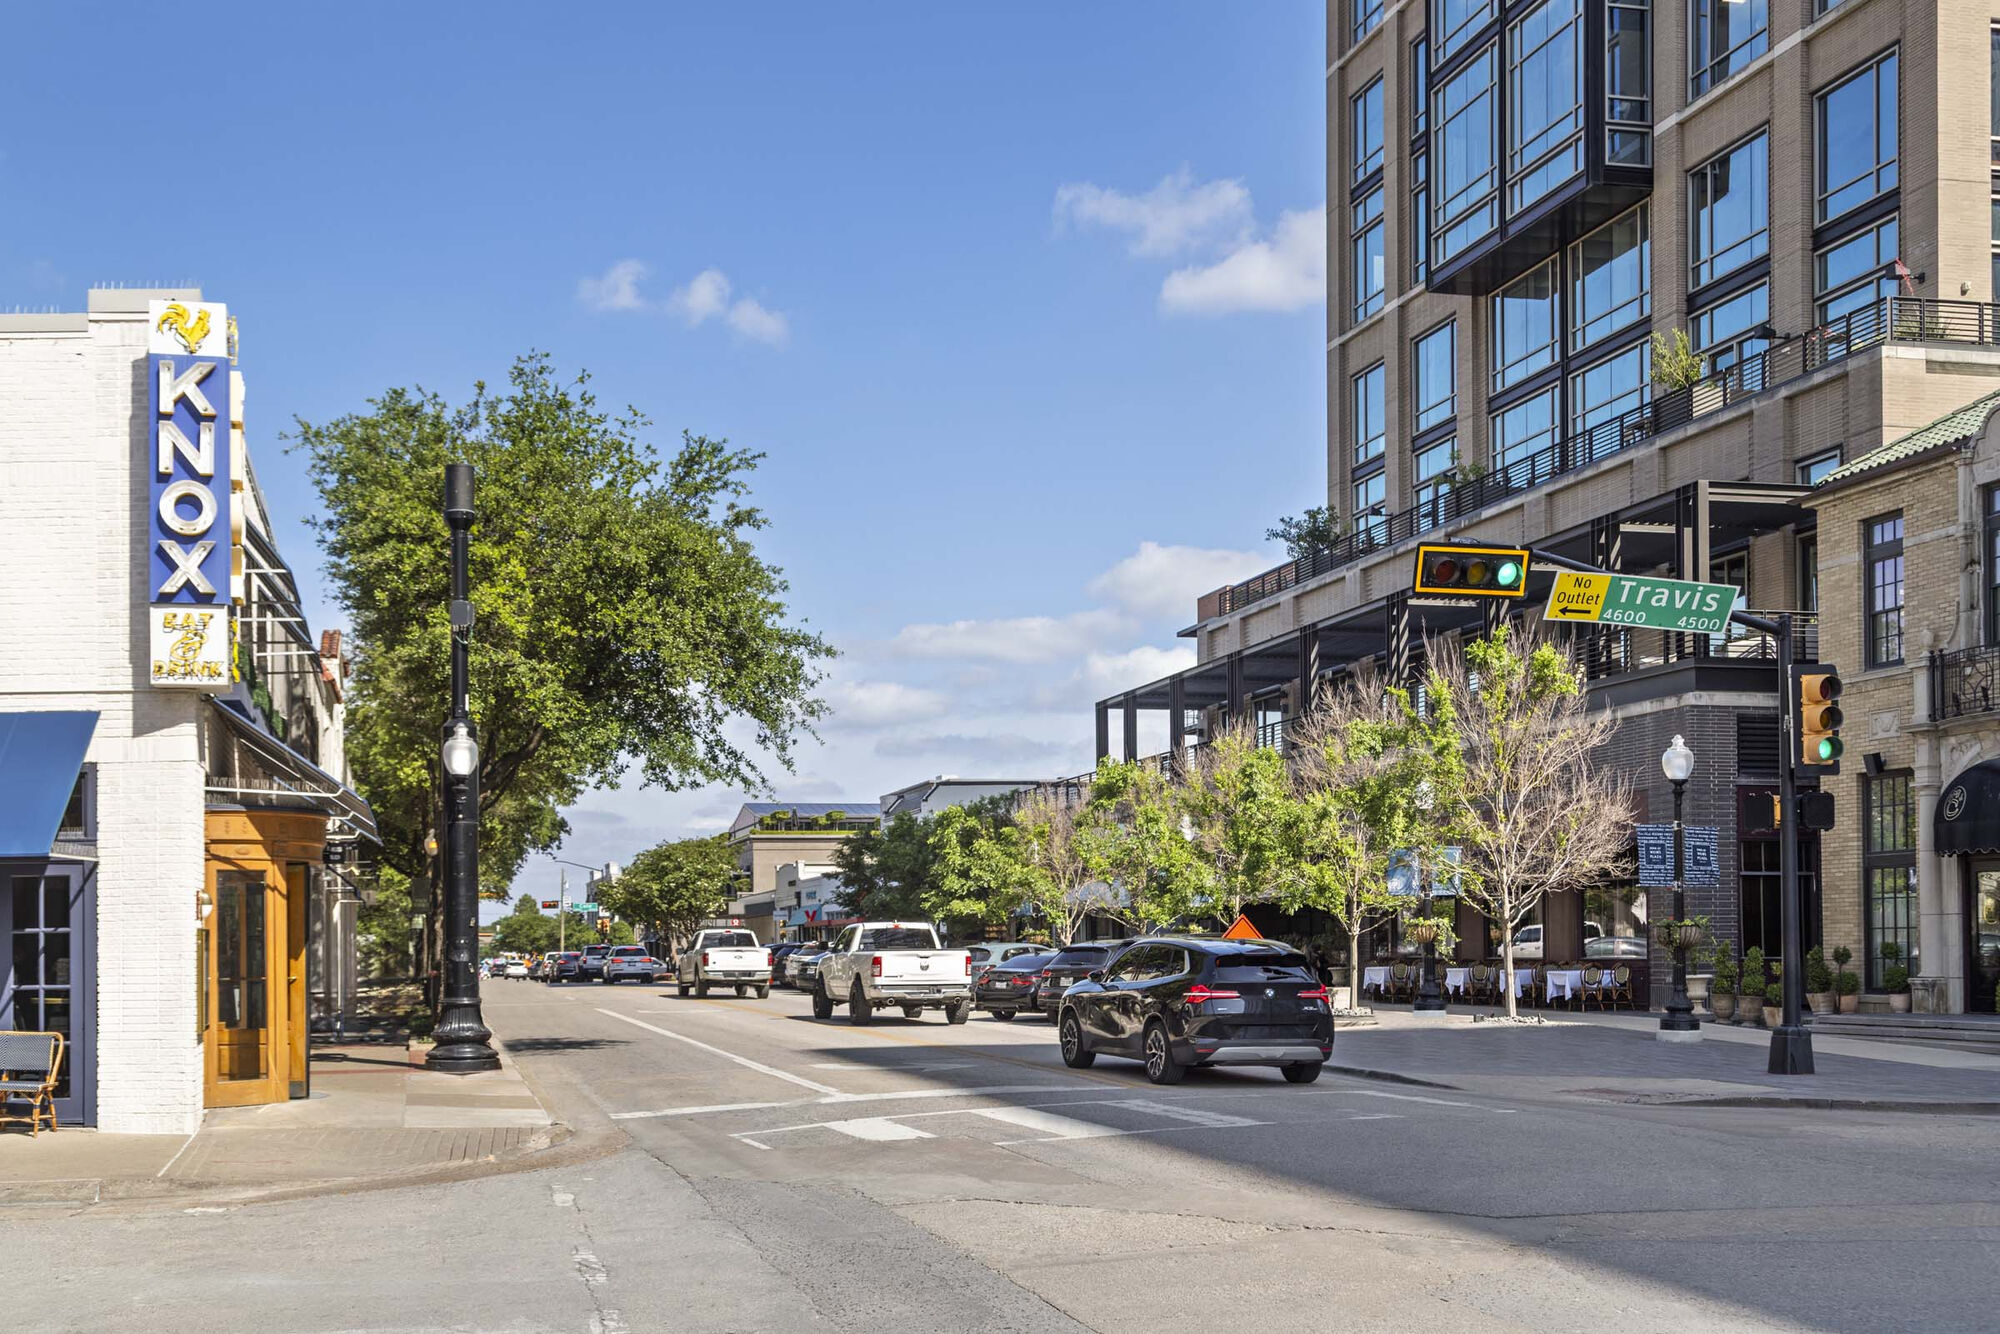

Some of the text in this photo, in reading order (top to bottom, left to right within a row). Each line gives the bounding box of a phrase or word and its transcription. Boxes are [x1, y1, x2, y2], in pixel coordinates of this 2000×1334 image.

[158, 361, 217, 595] KNOX
[1573, 576, 1592, 589] No
[1556, 591, 1601, 606] Outlet
[1619, 580, 1720, 612] Travis
[163, 612, 214, 631] EAT
[1602, 608, 1721, 631] 4600 4500
[153, 660, 224, 677] DRINK
